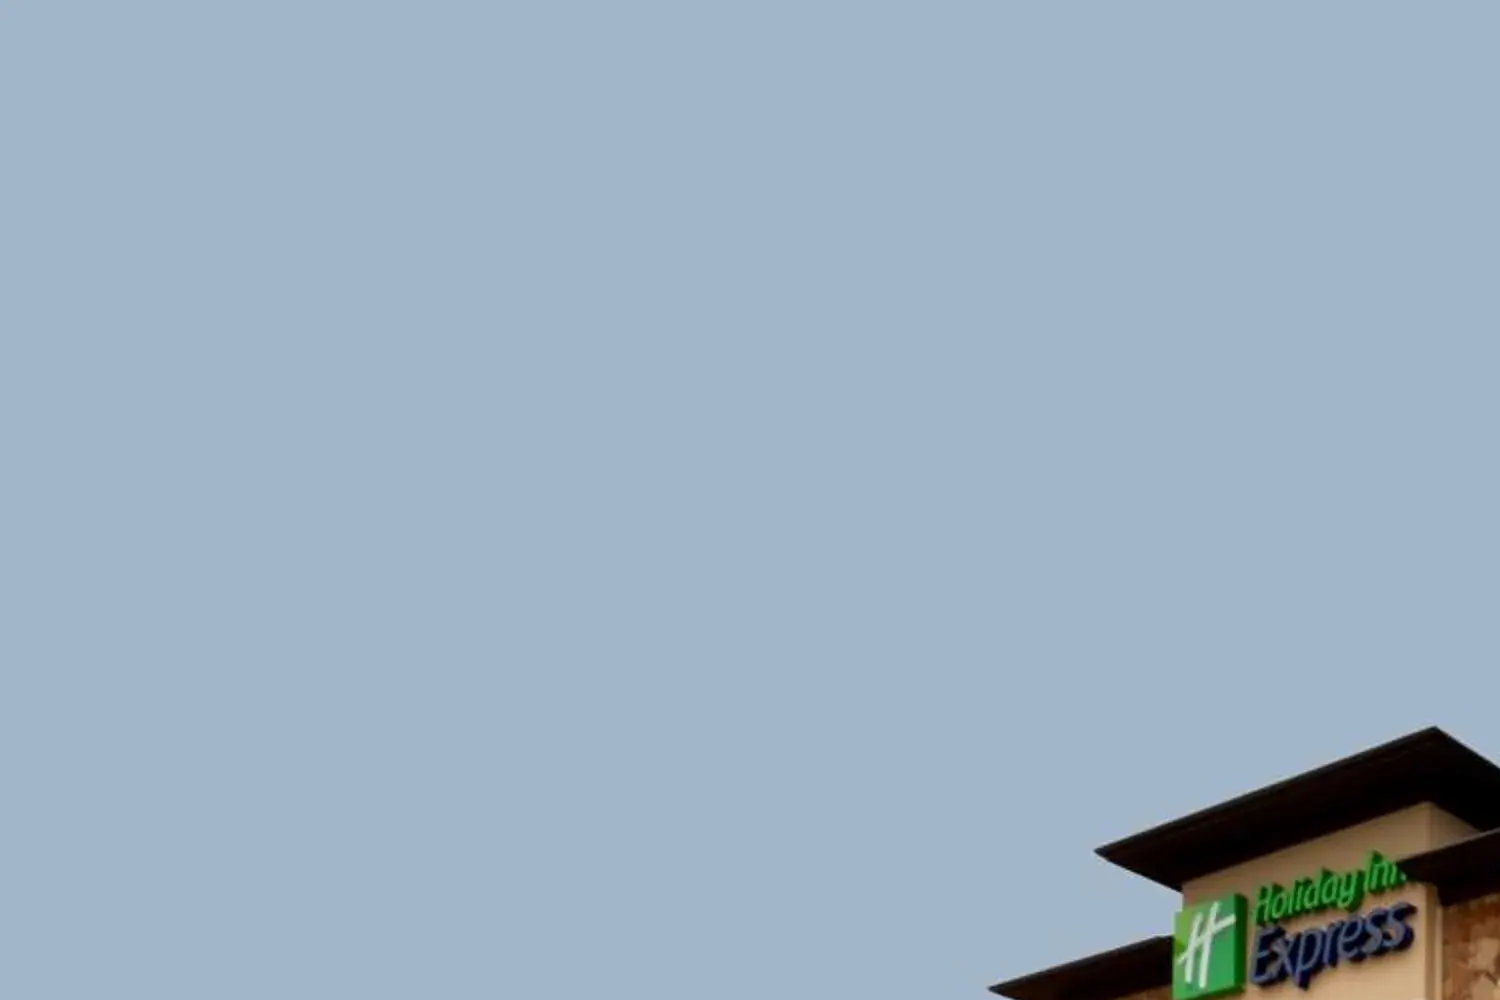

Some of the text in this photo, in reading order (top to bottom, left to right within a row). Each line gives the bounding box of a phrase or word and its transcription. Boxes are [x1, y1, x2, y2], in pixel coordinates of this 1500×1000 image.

[1252, 867, 1364, 925] Holiday
[1177, 900, 1237, 989] H
[1250, 902, 1417, 990] Express
